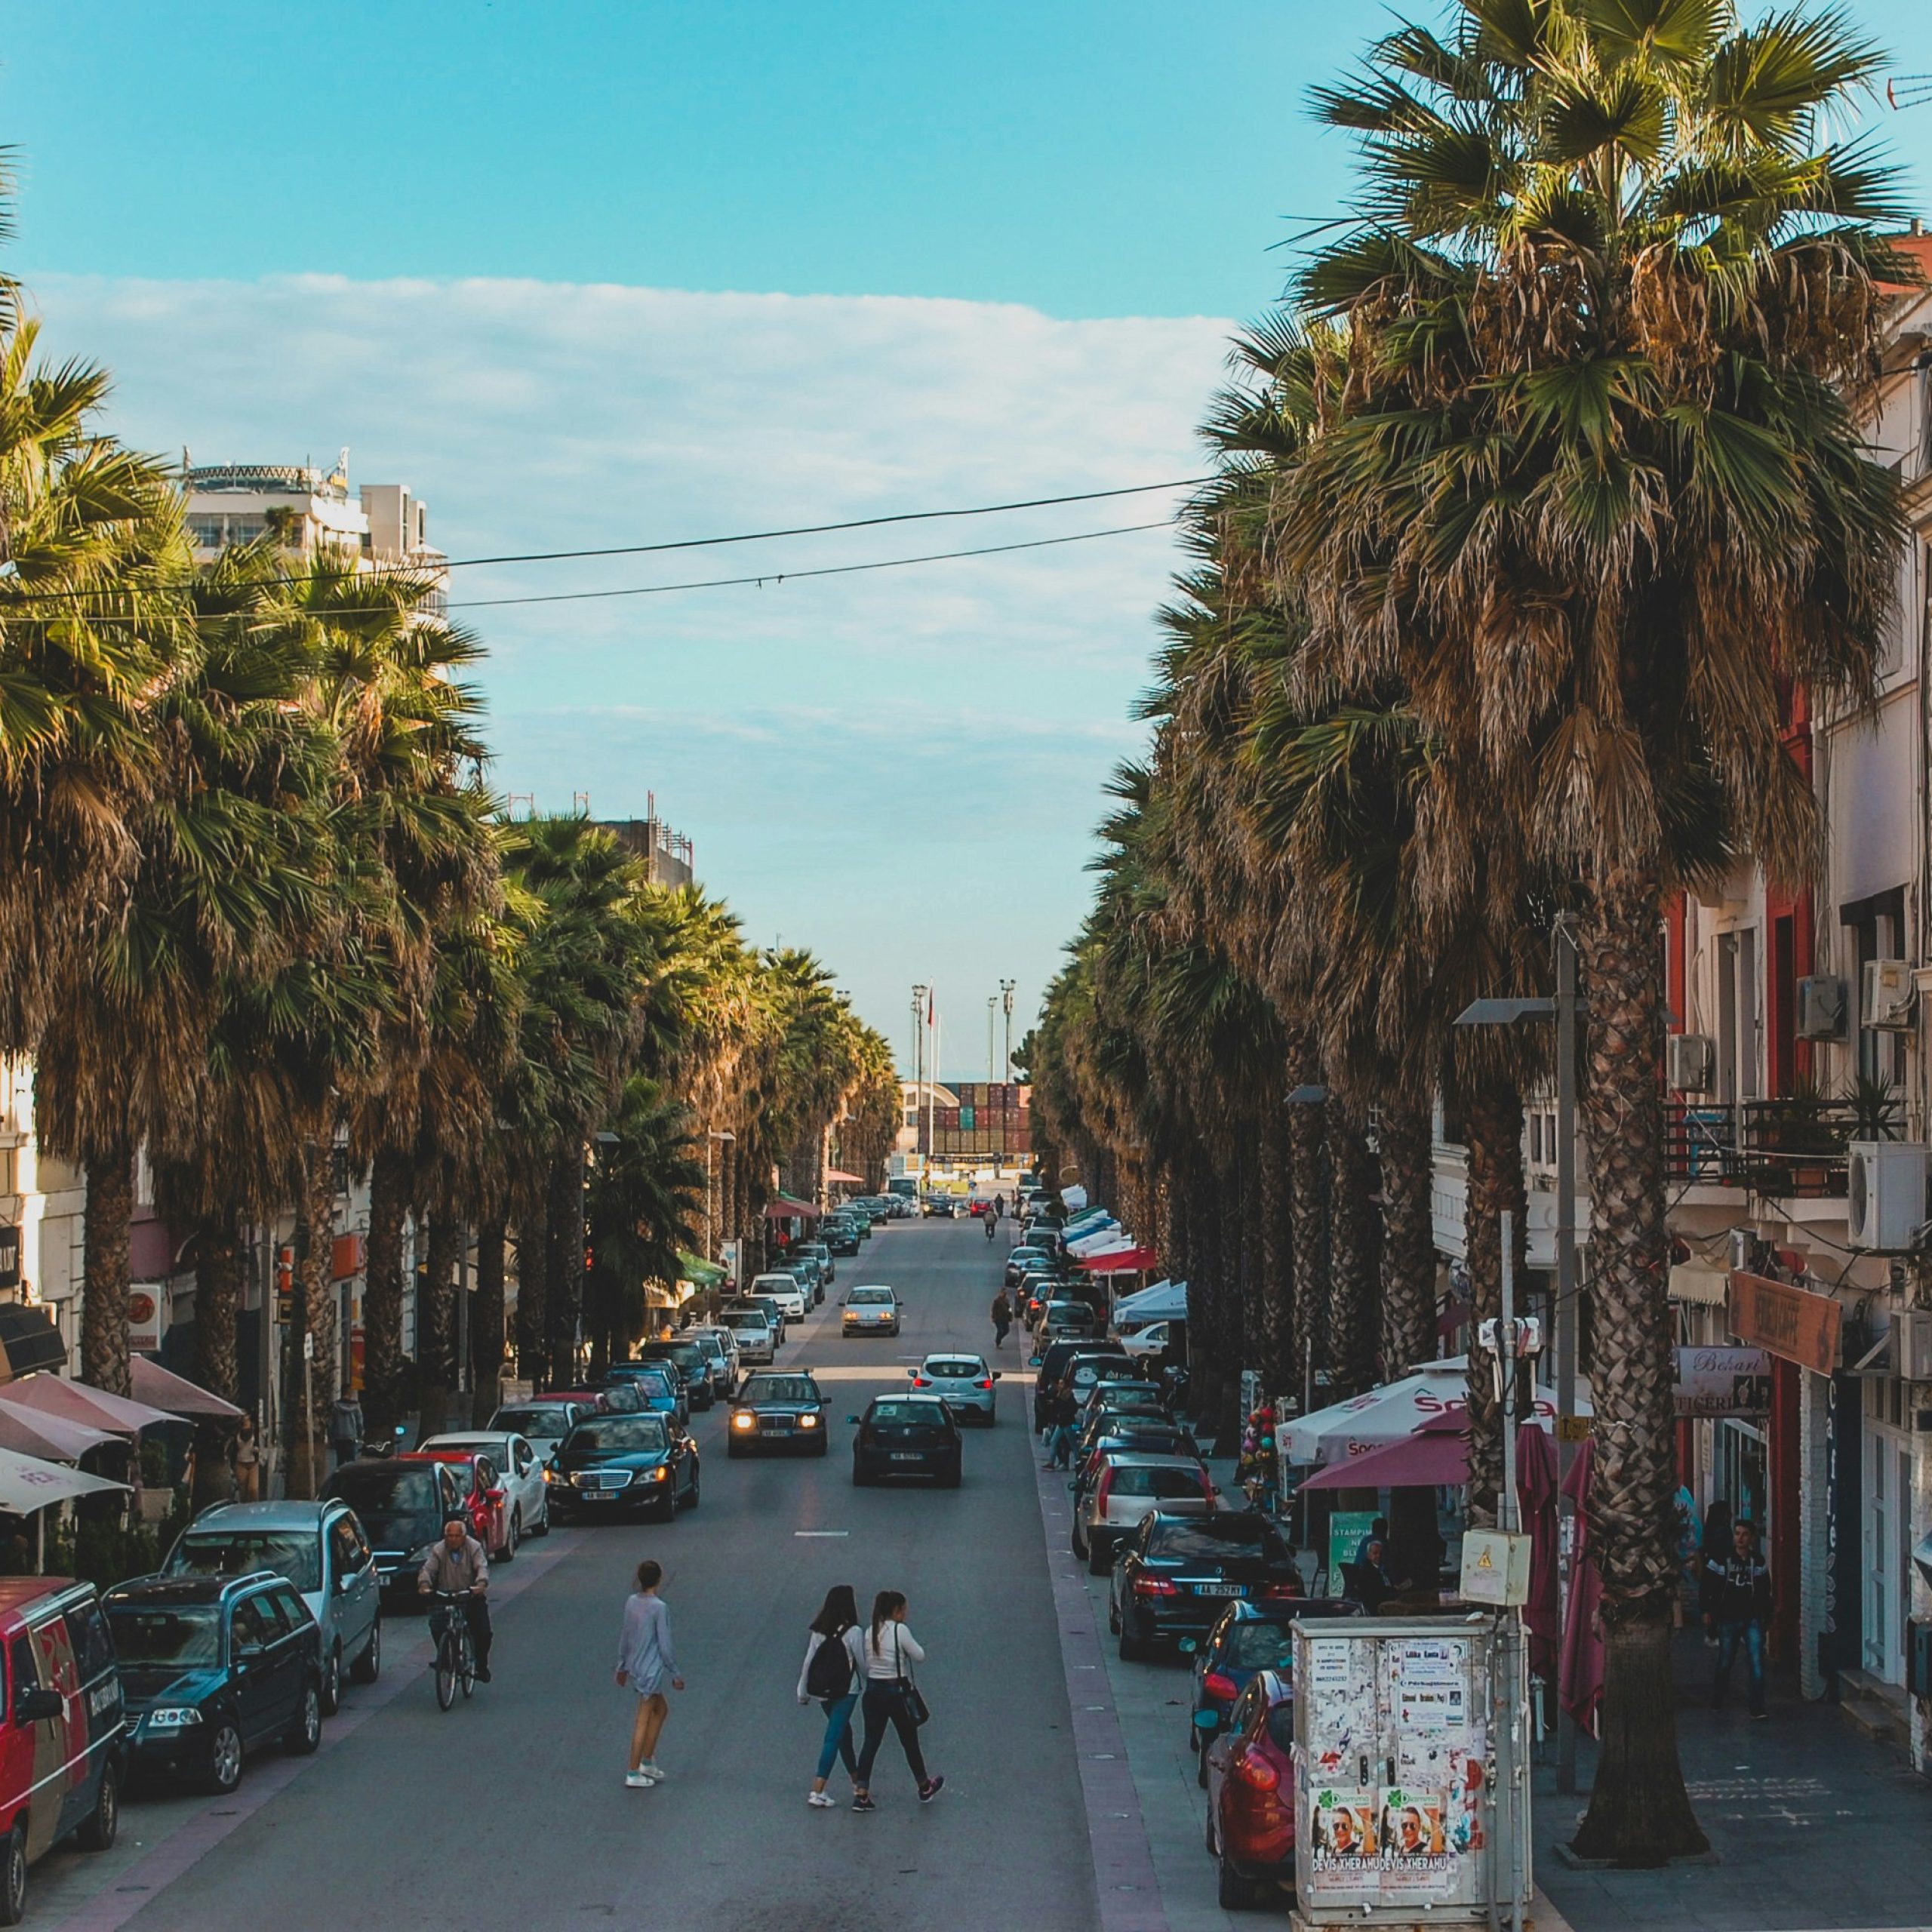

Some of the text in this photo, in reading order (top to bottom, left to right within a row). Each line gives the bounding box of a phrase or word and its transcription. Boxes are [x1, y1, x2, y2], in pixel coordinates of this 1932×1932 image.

[1313, 1857, 1380, 1872] DEVIS XHERAHU
[1380, 1857, 1446, 1872] DEVIS XHERAHU
